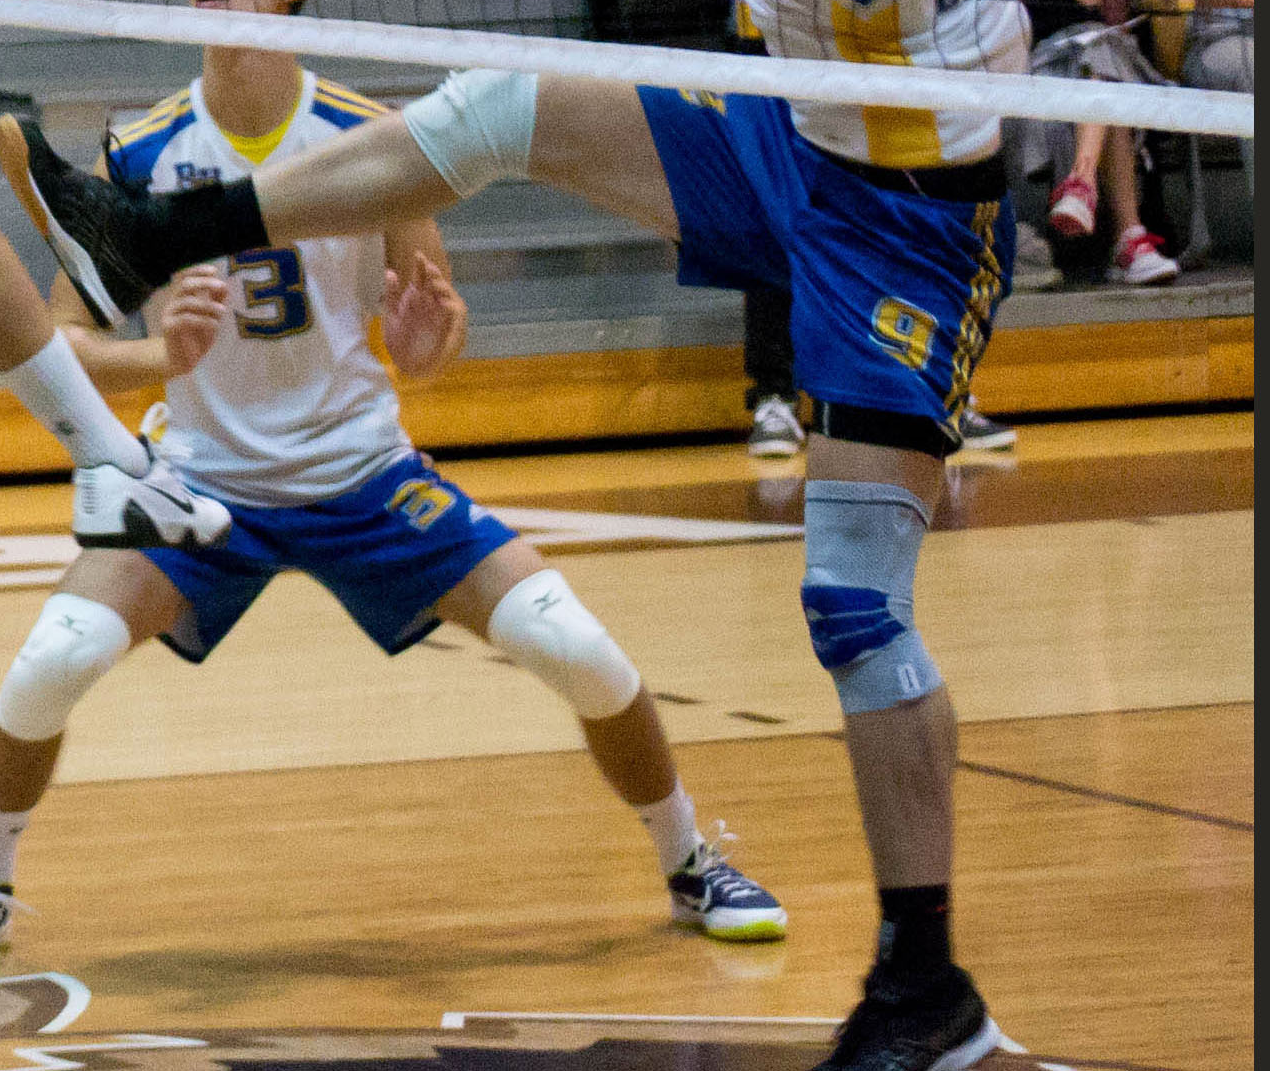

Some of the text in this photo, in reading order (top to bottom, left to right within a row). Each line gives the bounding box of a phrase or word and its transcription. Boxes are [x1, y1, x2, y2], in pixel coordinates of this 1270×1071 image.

[227, 246, 314, 340] 3
[869, 296, 939, 371] 9
[385, 479, 455, 531] 3
